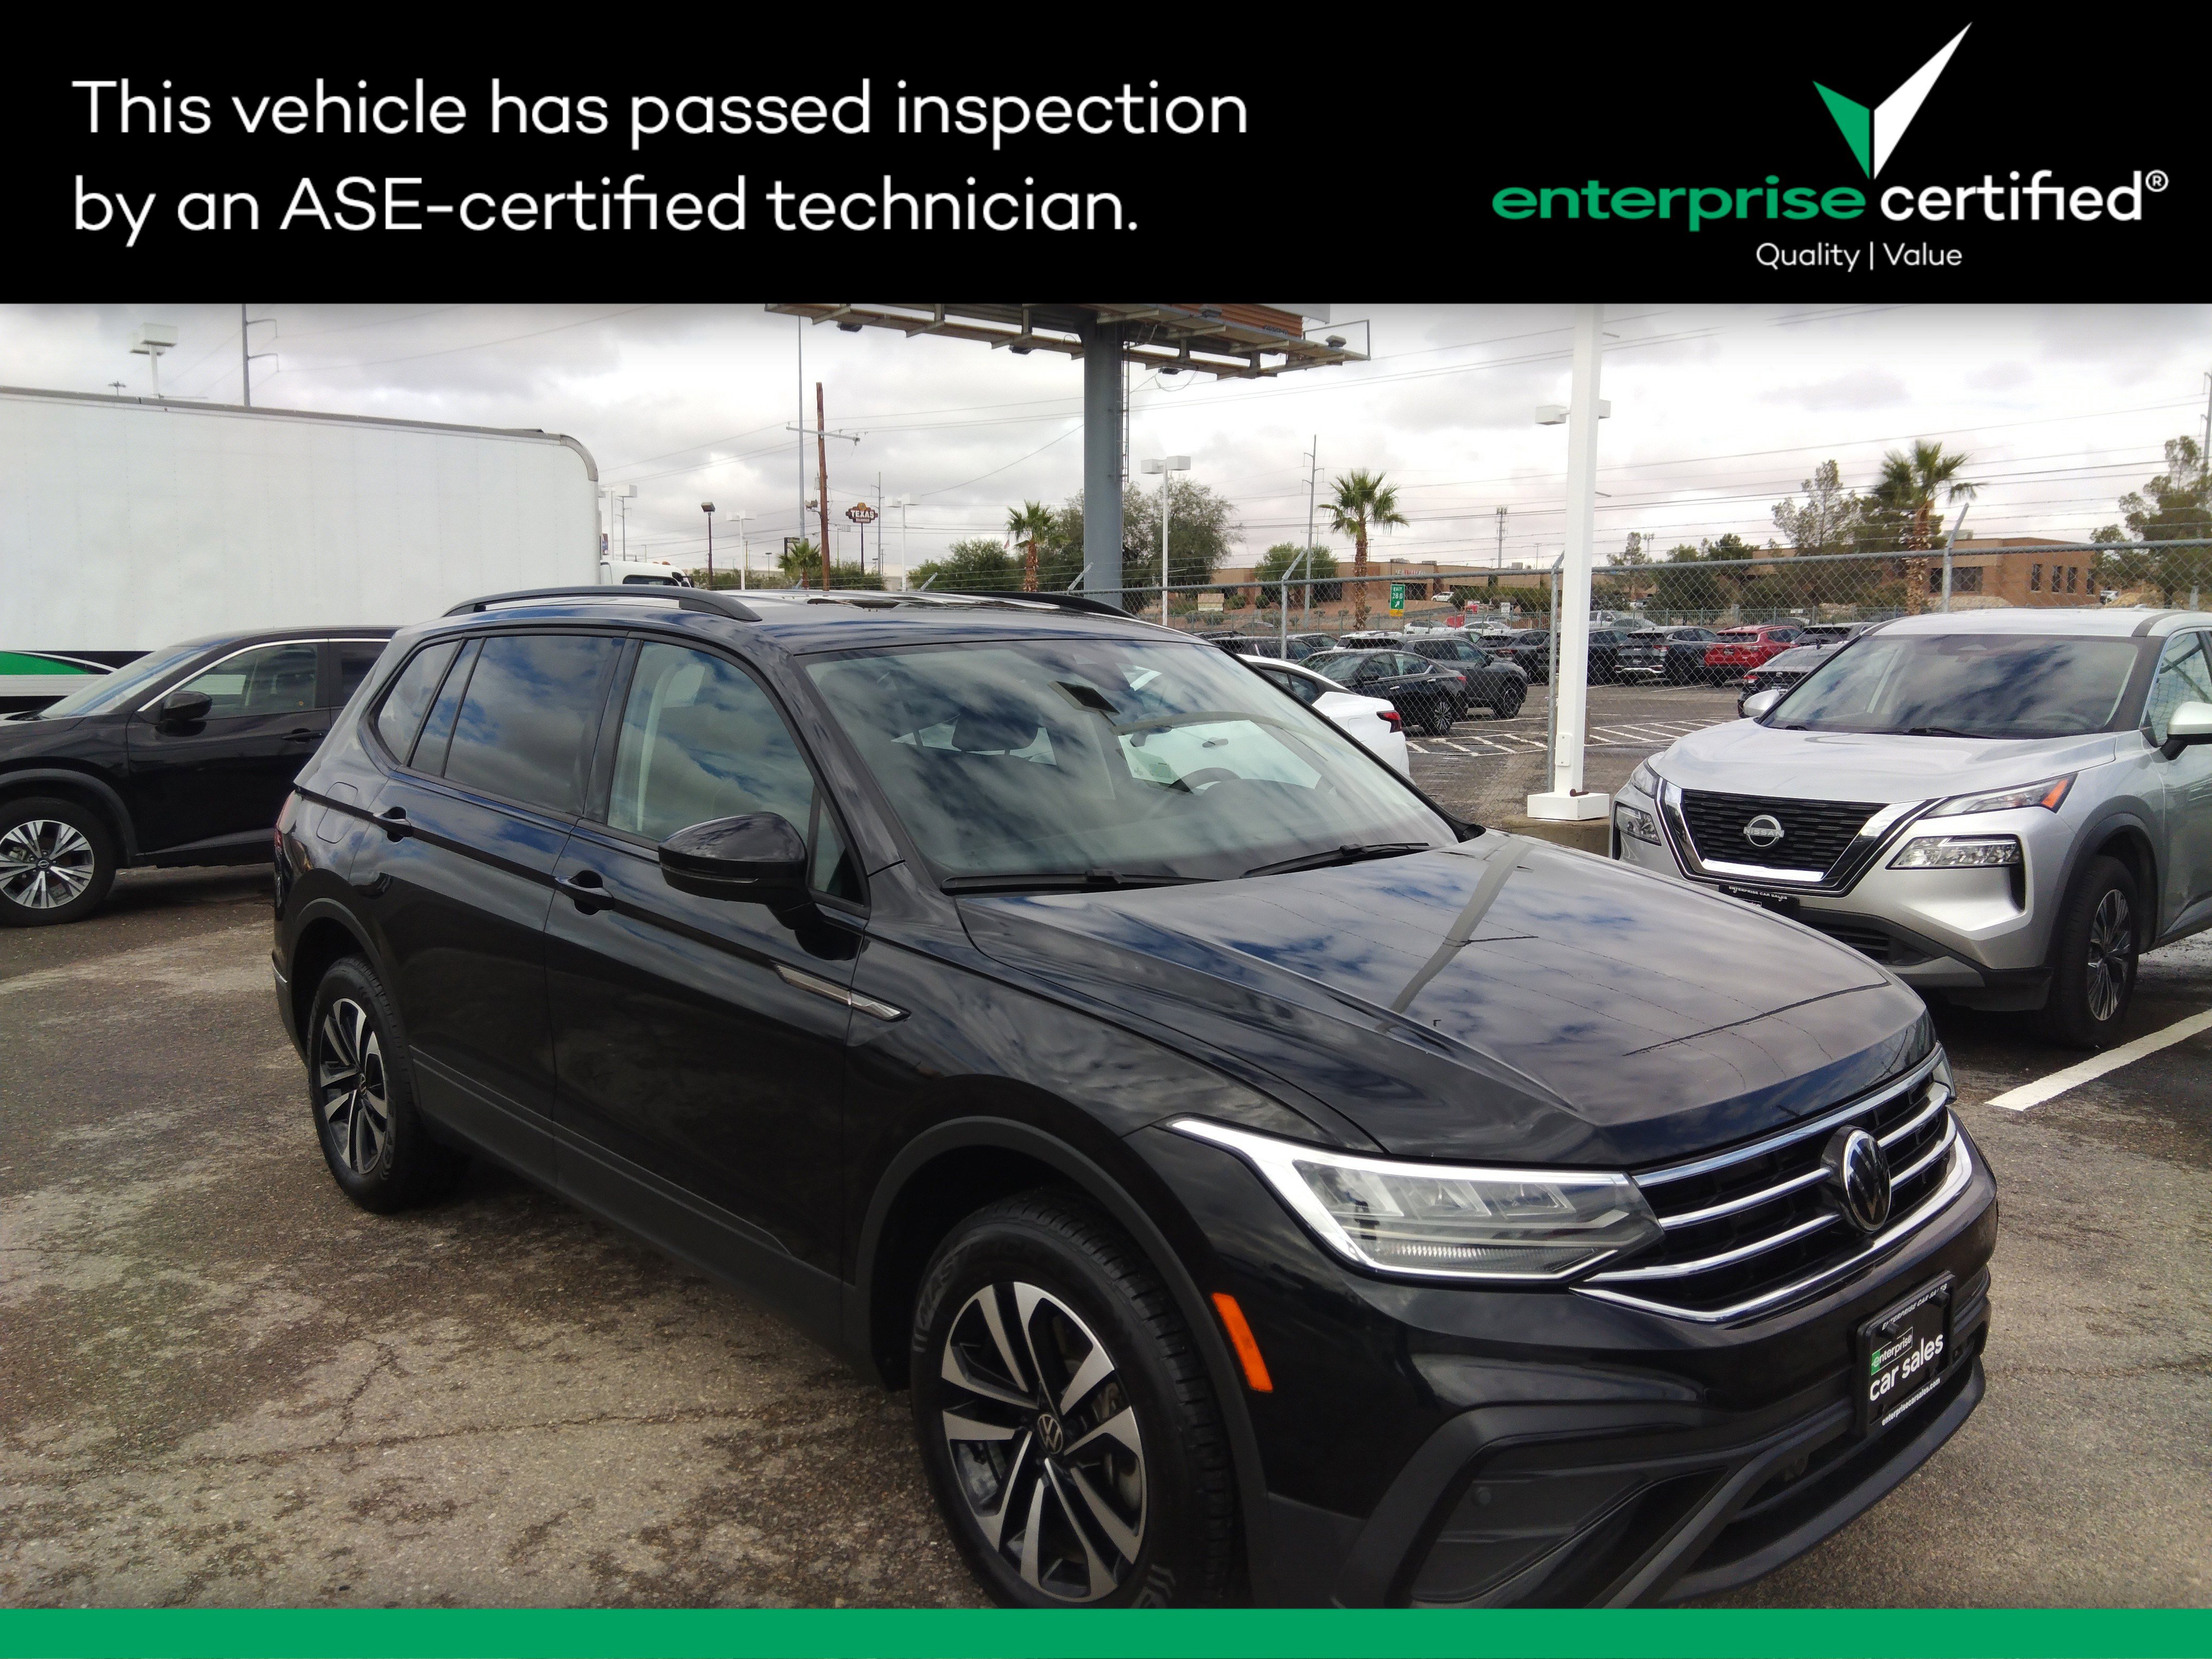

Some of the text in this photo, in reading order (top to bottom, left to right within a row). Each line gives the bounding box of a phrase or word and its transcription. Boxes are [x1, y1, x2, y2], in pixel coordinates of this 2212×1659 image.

[1744, 828, 1783, 837] NISSAN
[1917, 1294, 1929, 1306] CAR
[1870, 1334, 1943, 1401] car sales
[1872, 1334, 1912, 1368] enterprise
[1882, 1378, 1940, 1426] enterprisecarsales.com
